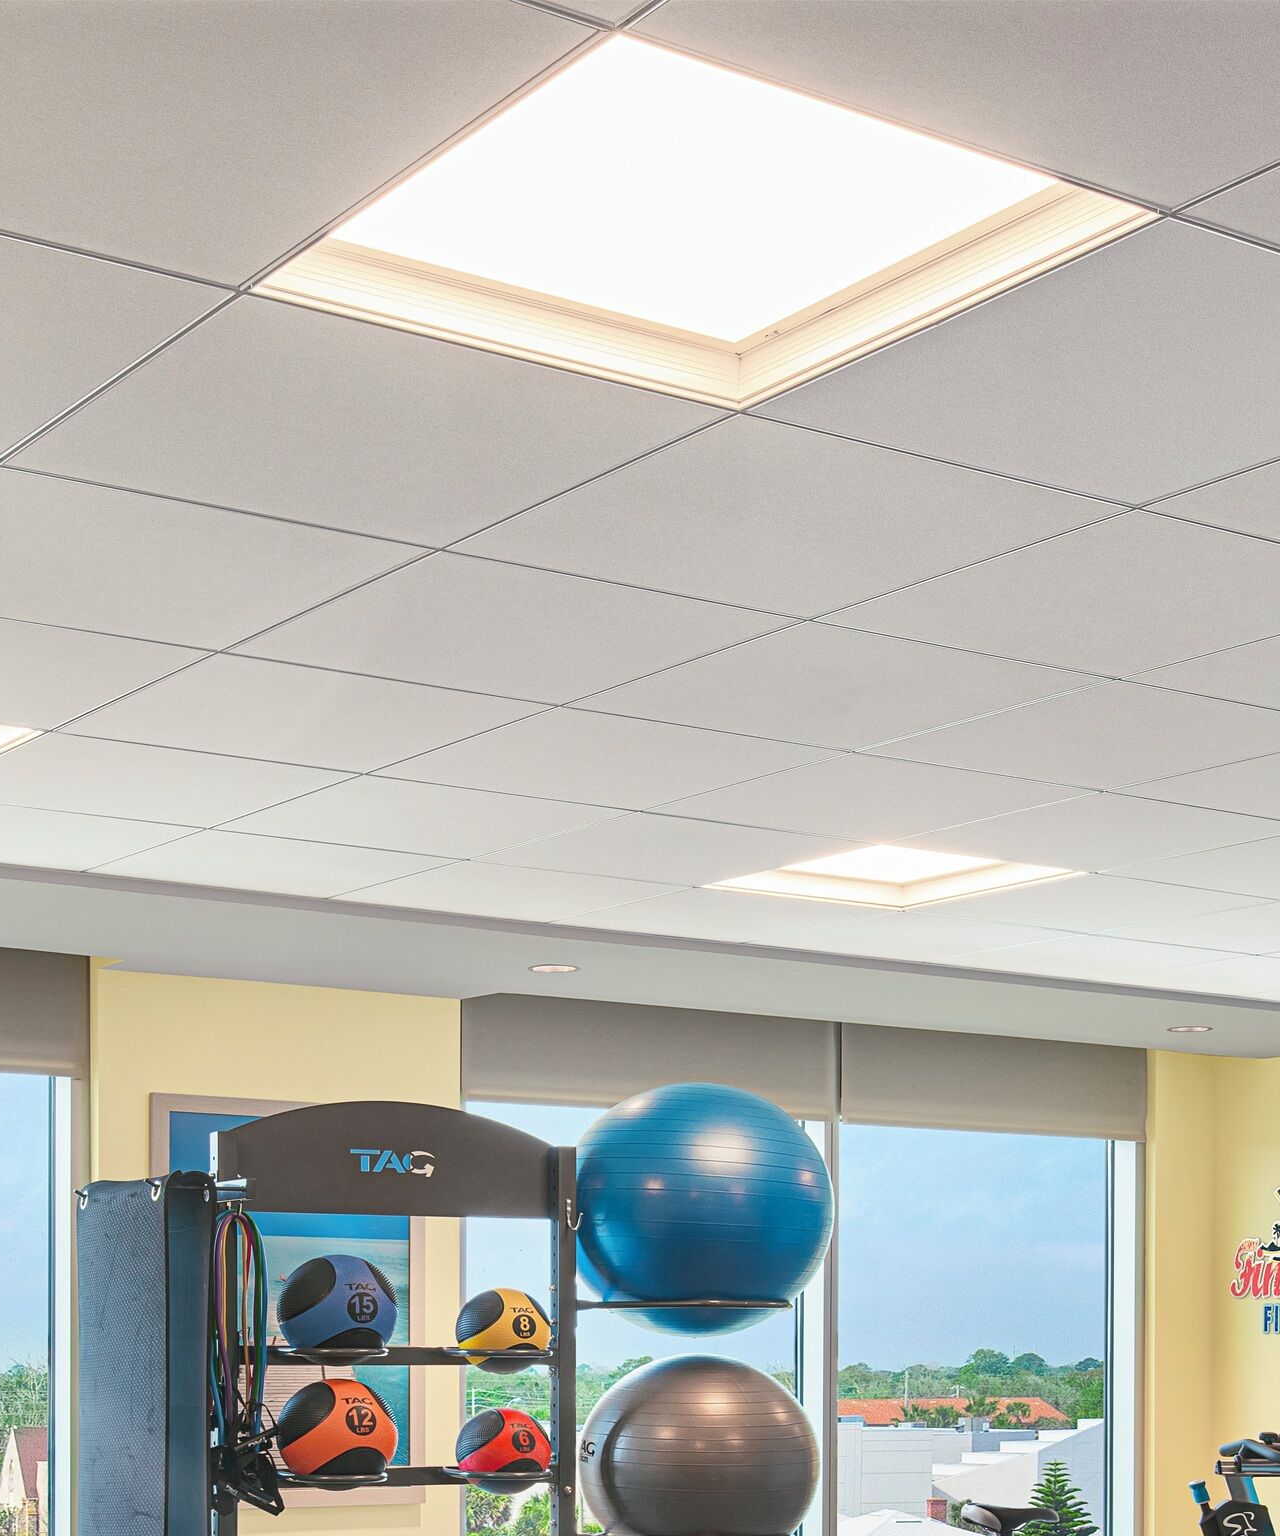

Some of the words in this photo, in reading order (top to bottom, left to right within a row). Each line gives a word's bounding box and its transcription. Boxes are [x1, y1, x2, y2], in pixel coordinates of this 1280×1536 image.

[349, 1148, 436, 1178] TAG
[344, 1283, 377, 1292] TAG
[351, 1296, 374, 1314] 15
[509, 1306, 534, 1314] TAG
[519, 1316, 530, 1331] 8
[341, 1397, 374, 1406] TAG
[348, 1407, 374, 1426] 12
[518, 1431, 530, 1447] 6
[580, 1440, 597, 1457] AG
